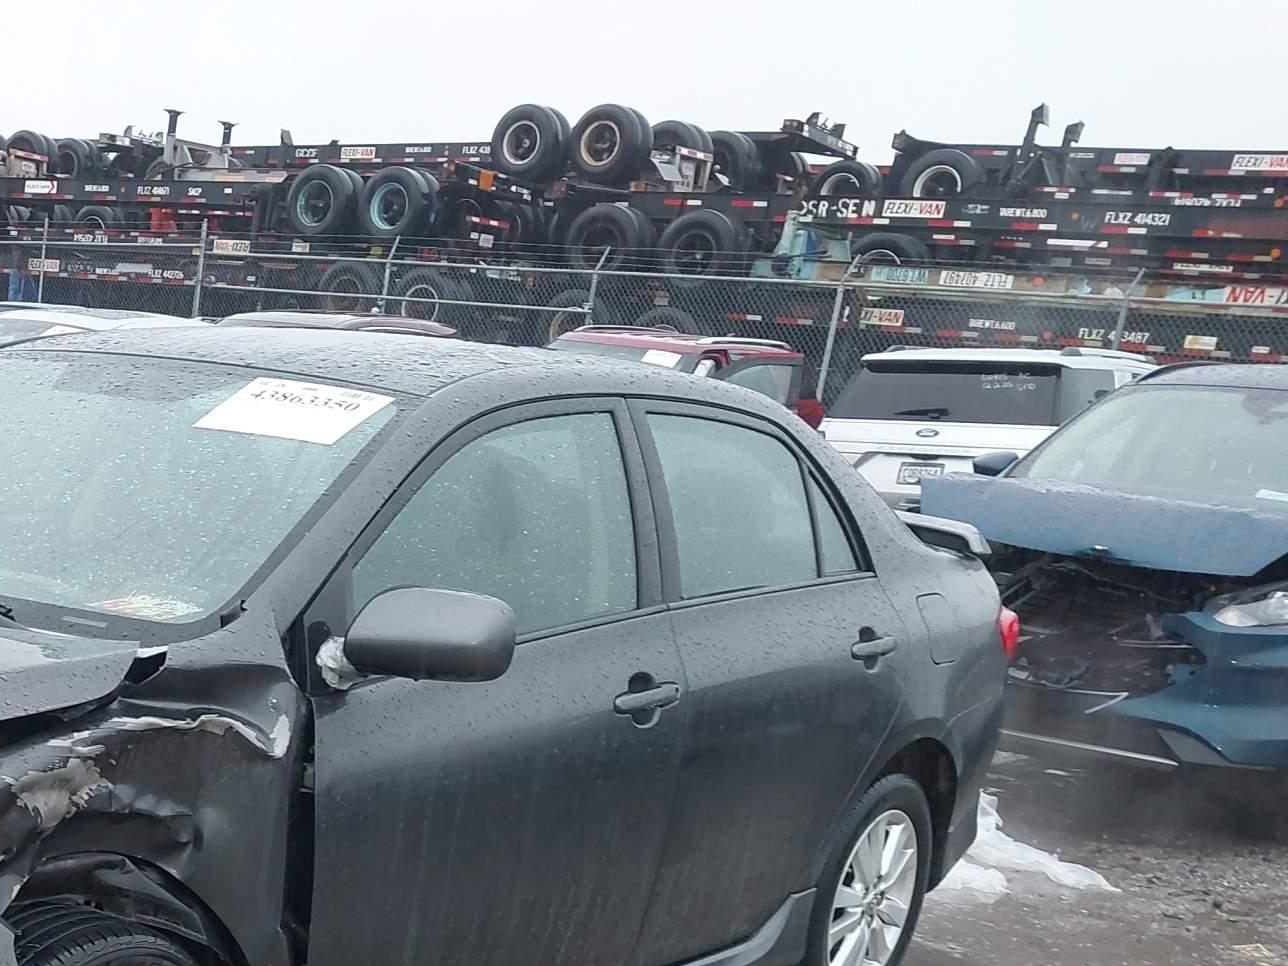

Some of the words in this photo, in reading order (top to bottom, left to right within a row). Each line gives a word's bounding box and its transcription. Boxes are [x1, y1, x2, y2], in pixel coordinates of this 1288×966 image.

[884, 202, 944, 217] FLEXI-VAN
[1104, 211, 1130, 224] FLXZ
[1133, 213, 1171, 226] 414321
[1078, 328, 1104, 339] FLXZ
[1107, 329, 1150, 343] 43487
